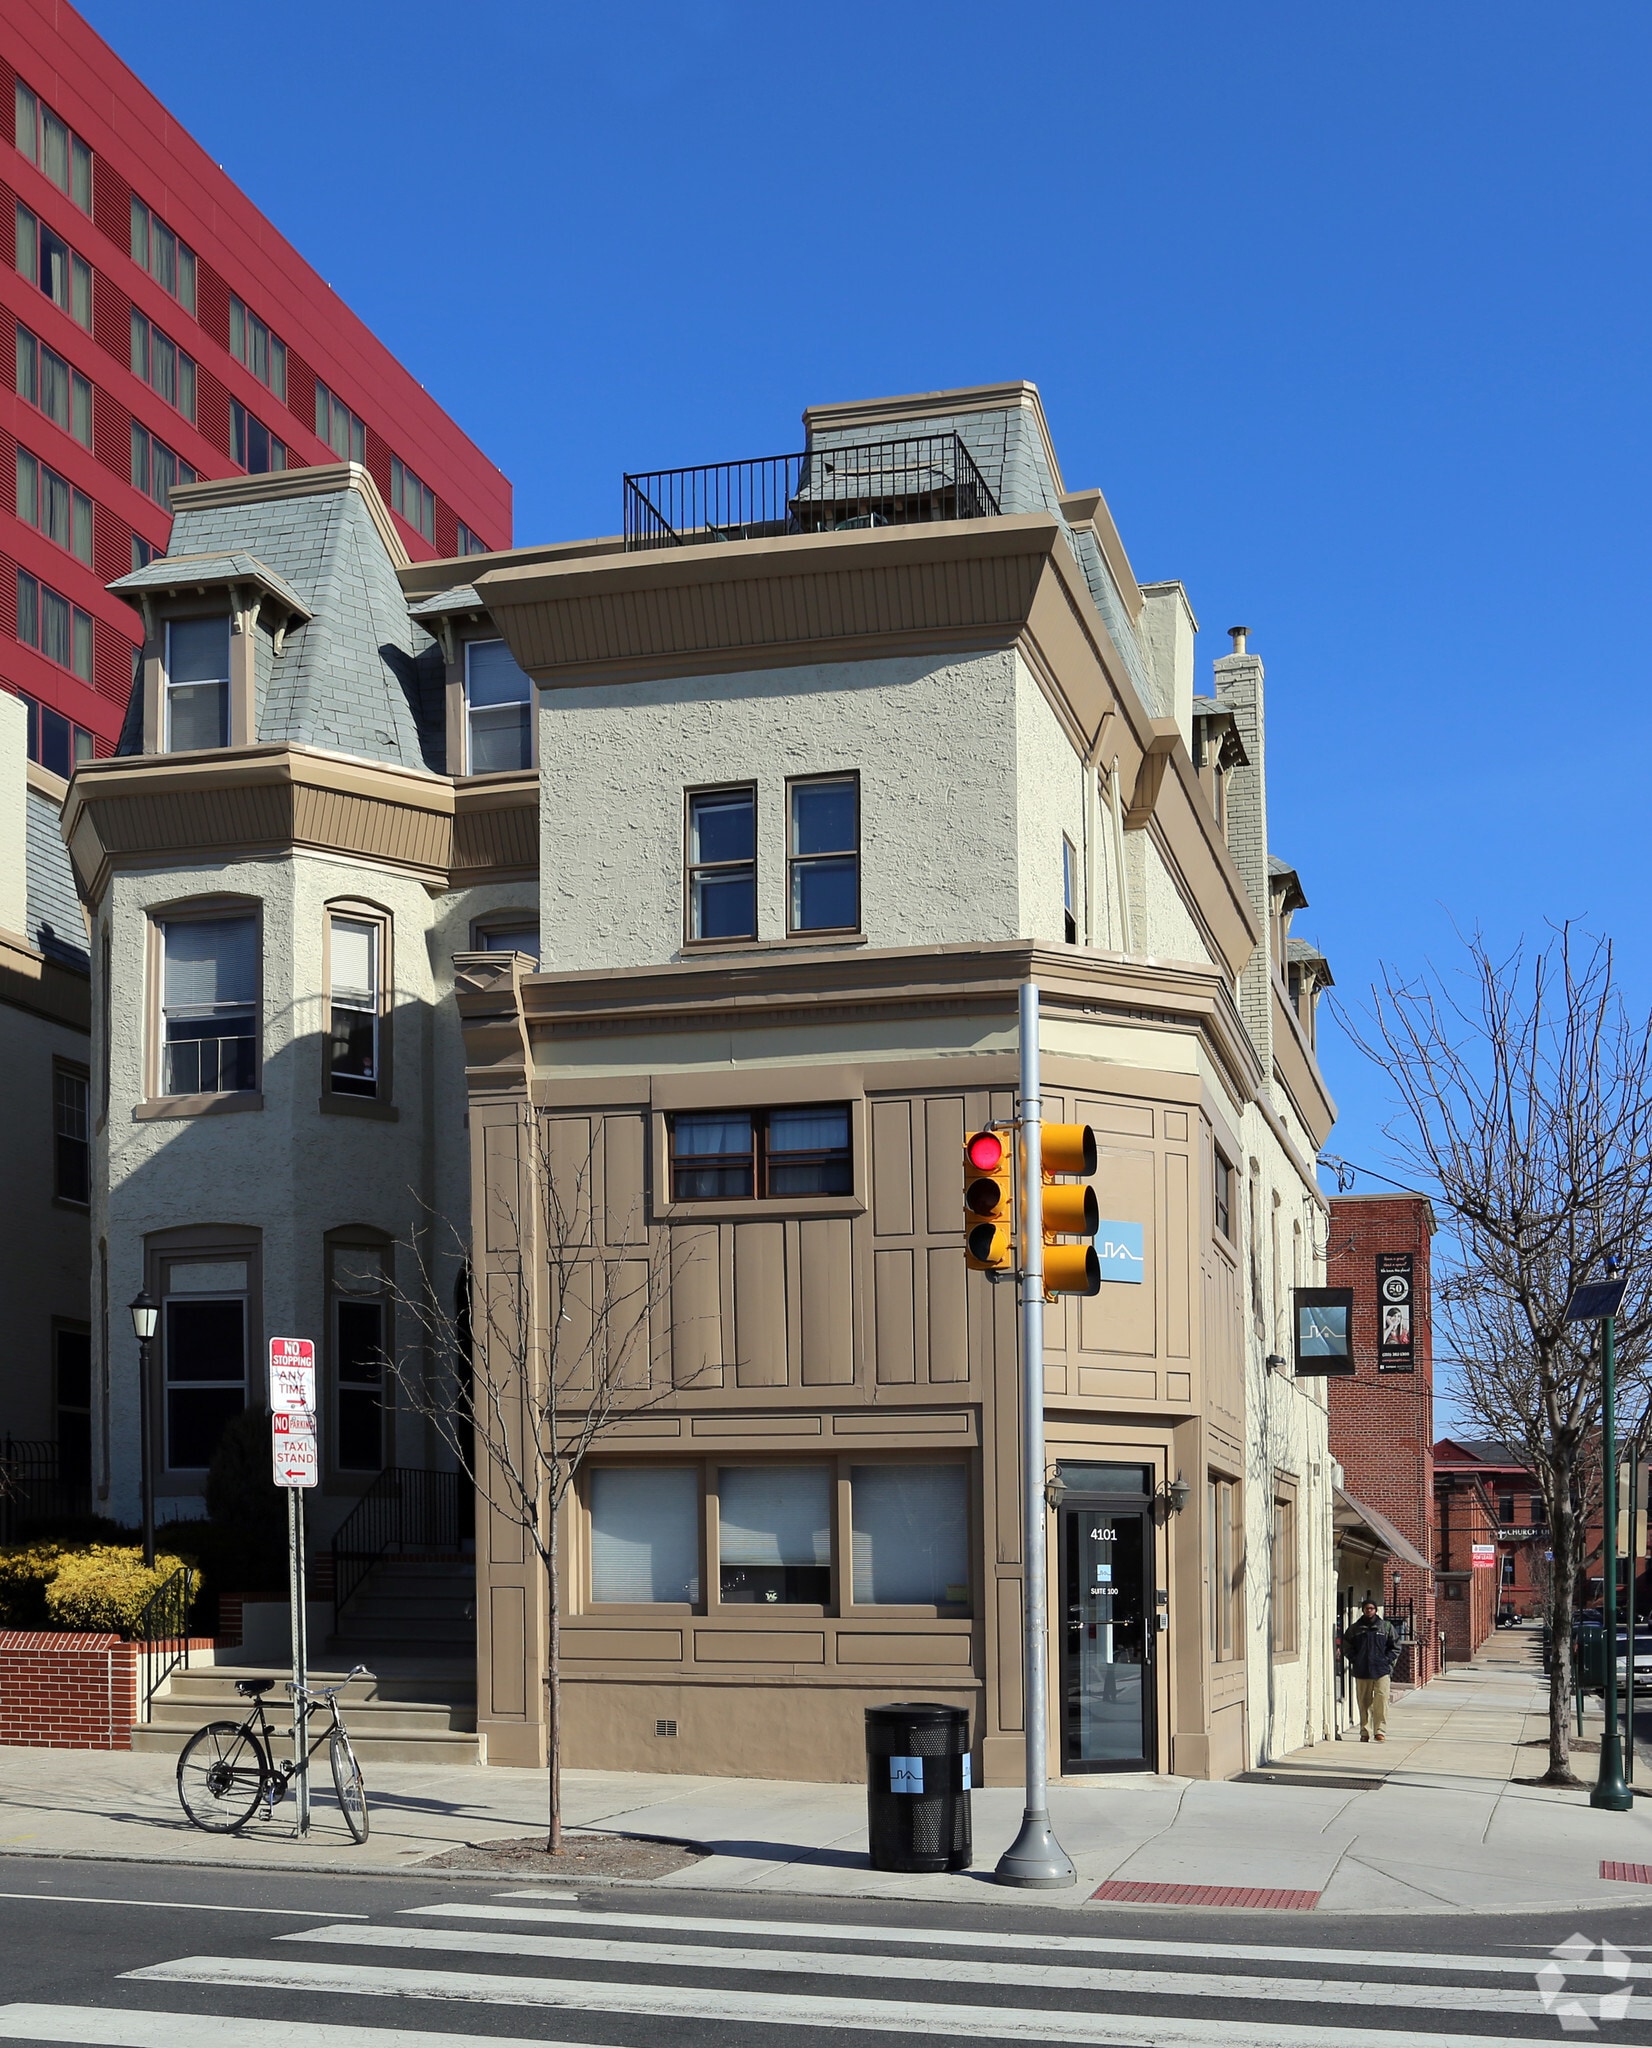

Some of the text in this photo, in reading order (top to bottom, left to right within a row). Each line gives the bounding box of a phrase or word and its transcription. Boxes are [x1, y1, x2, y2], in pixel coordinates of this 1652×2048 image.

[1389, 1284, 1402, 1294] 50
[284, 1341, 300, 1355] NO
[273, 1355, 312, 1366] STOPPING
[279, 1371, 305, 1381] ANY
[279, 1383, 307, 1395] TIME
[275, 1416, 288, 1431] NO
[282, 1442, 308, 1451] TAXI
[277, 1453, 314, 1464] STAND
[1090, 1528, 1118, 1540] 4101
